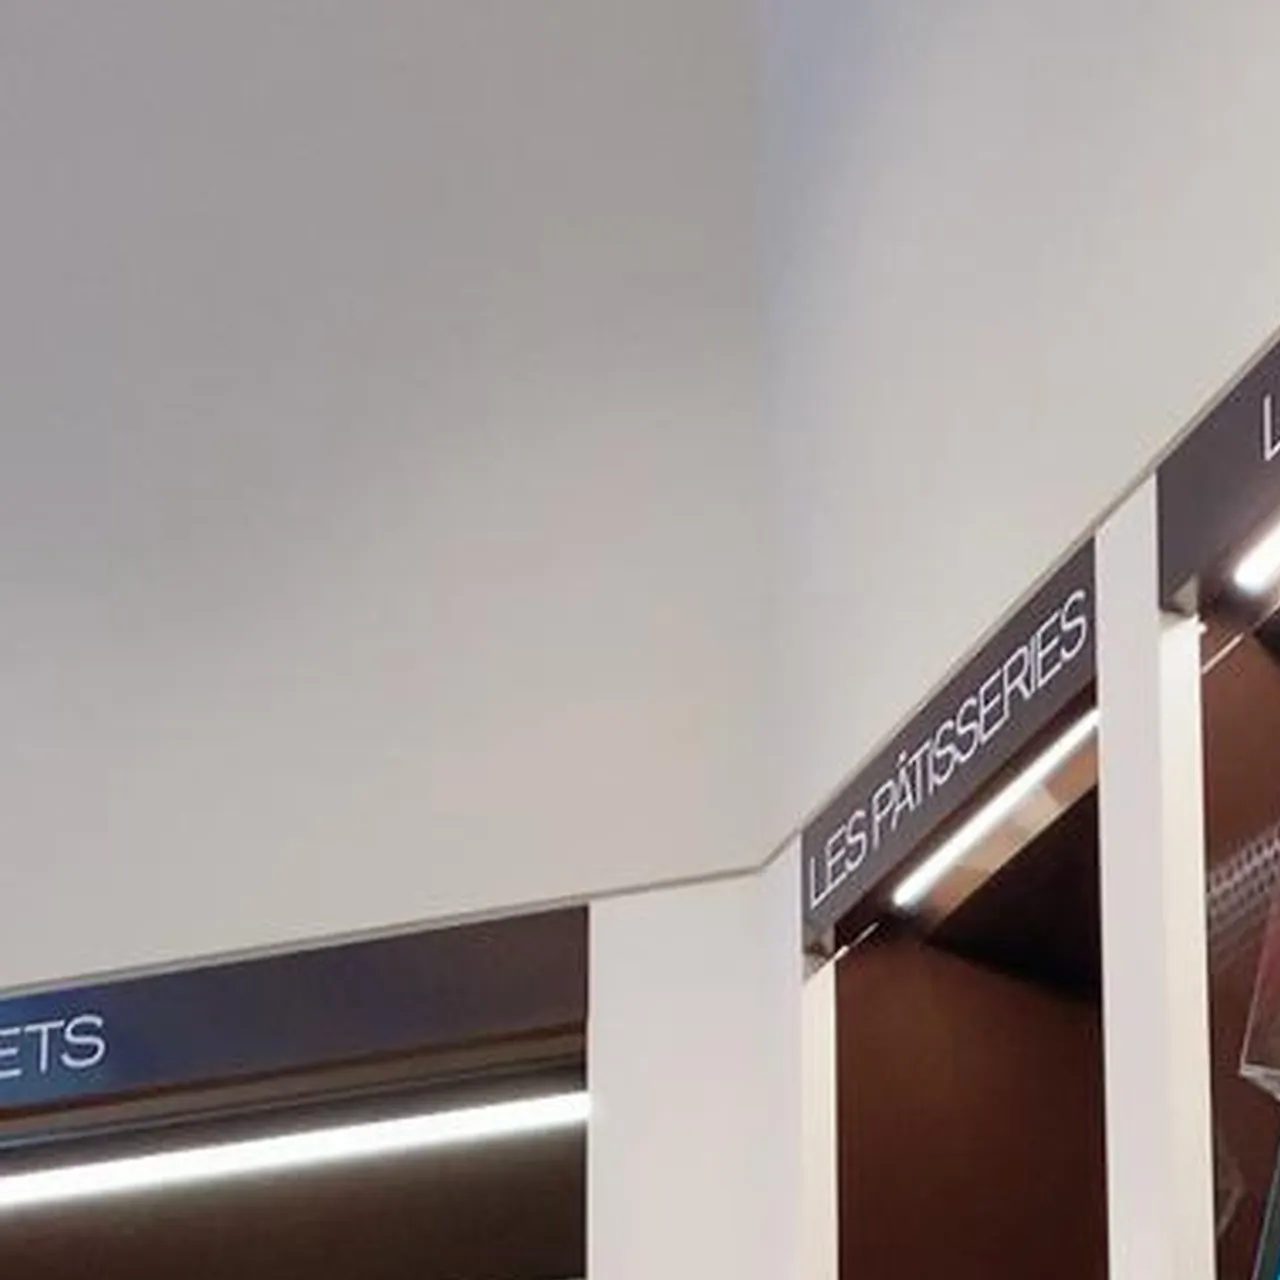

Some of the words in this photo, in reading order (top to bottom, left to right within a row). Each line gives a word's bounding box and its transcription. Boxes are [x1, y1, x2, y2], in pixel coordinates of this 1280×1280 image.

[809, 808, 869, 909] LES
[871, 587, 1088, 850] PÂTISSERIES
[0, 1014, 106, 1079] ETS
